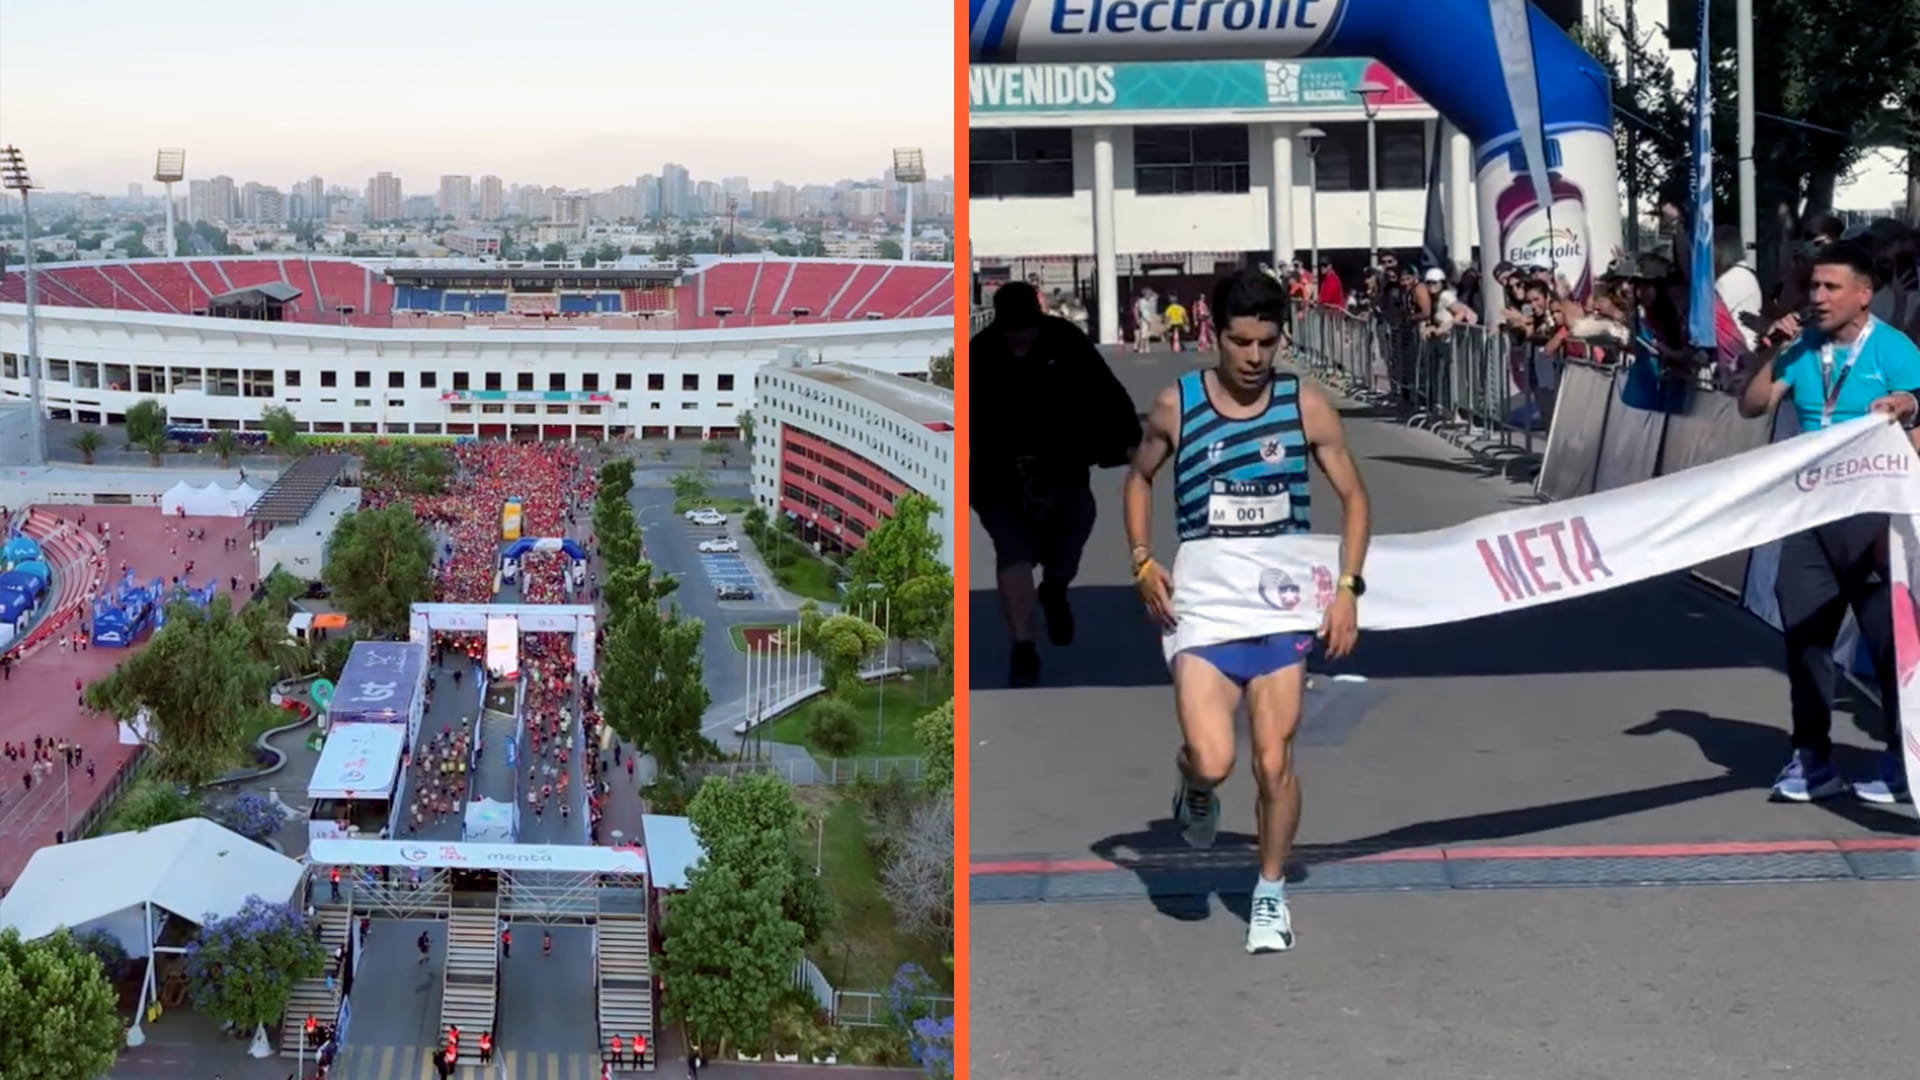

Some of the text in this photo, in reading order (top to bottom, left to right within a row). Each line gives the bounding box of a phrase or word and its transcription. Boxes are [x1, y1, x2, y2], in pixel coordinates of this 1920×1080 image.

[1050, 0, 1319, 34] Electrolit
[1509, 242, 1583, 262] Electrolit
[1824, 454, 1909, 479] FEDACHI
[1213, 507, 1265, 521] M 001
[1475, 516, 1614, 602] META
[486, 851, 552, 862] menta
